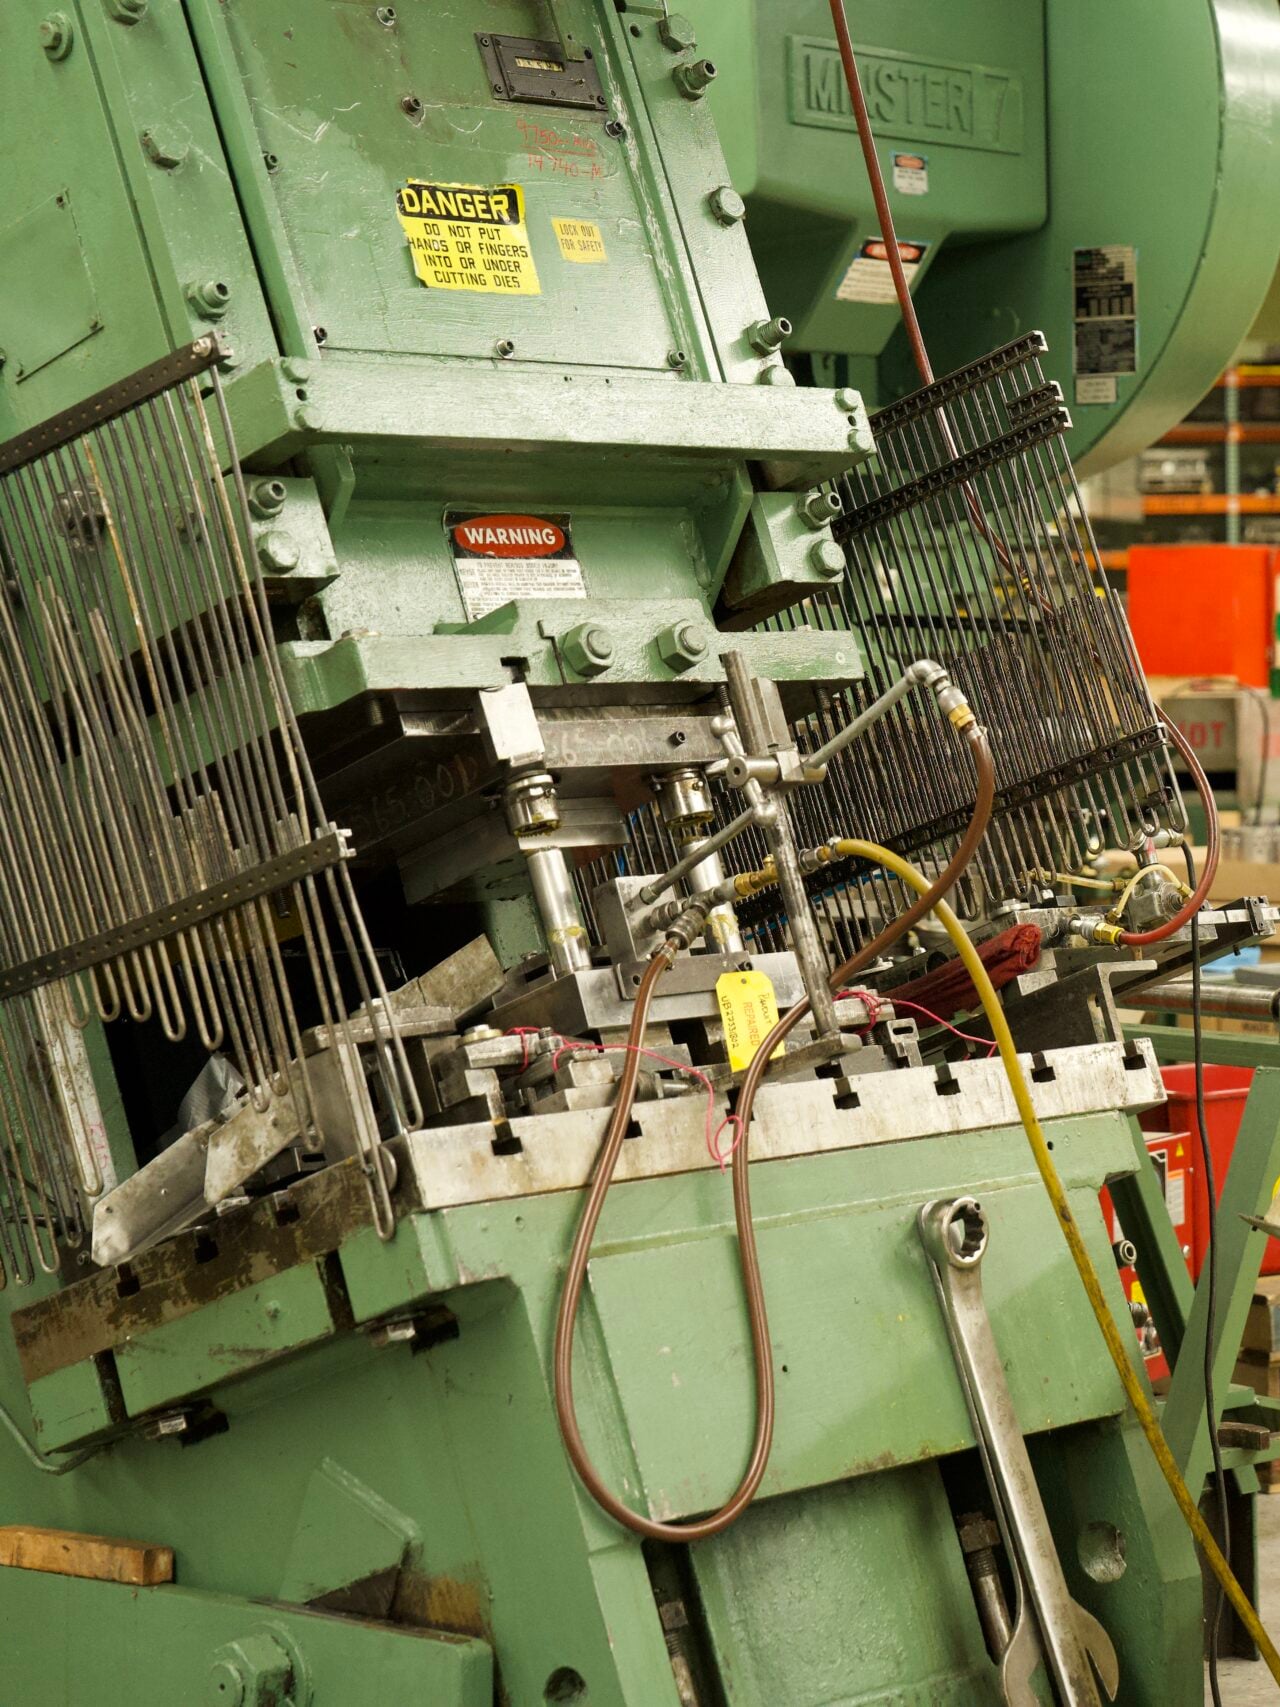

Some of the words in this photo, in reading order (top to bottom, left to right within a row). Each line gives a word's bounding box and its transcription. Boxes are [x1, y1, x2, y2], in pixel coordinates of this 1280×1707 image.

[401, 187, 510, 222] DANGER
[423, 223, 441, 236] DO
[449, 225, 471, 239] NOT
[479, 227, 501, 241] PUT
[559, 223, 579, 236] LOCK
[581, 225, 595, 237] OUT
[408, 237, 448, 252] HANDS
[456, 241, 472, 254] OR
[479, 243, 529, 258] FINGERS
[561, 239, 576, 251] FOR
[424, 254, 452, 268] INTO
[460, 257, 475, 270] OR
[484, 259, 521, 273] UNDER
[434, 271, 487, 287] CUTTING
[493, 274, 521, 289] DIES
[464, 527, 556, 545] WARNING
[743, 1001, 760, 1047] REPAIRED
